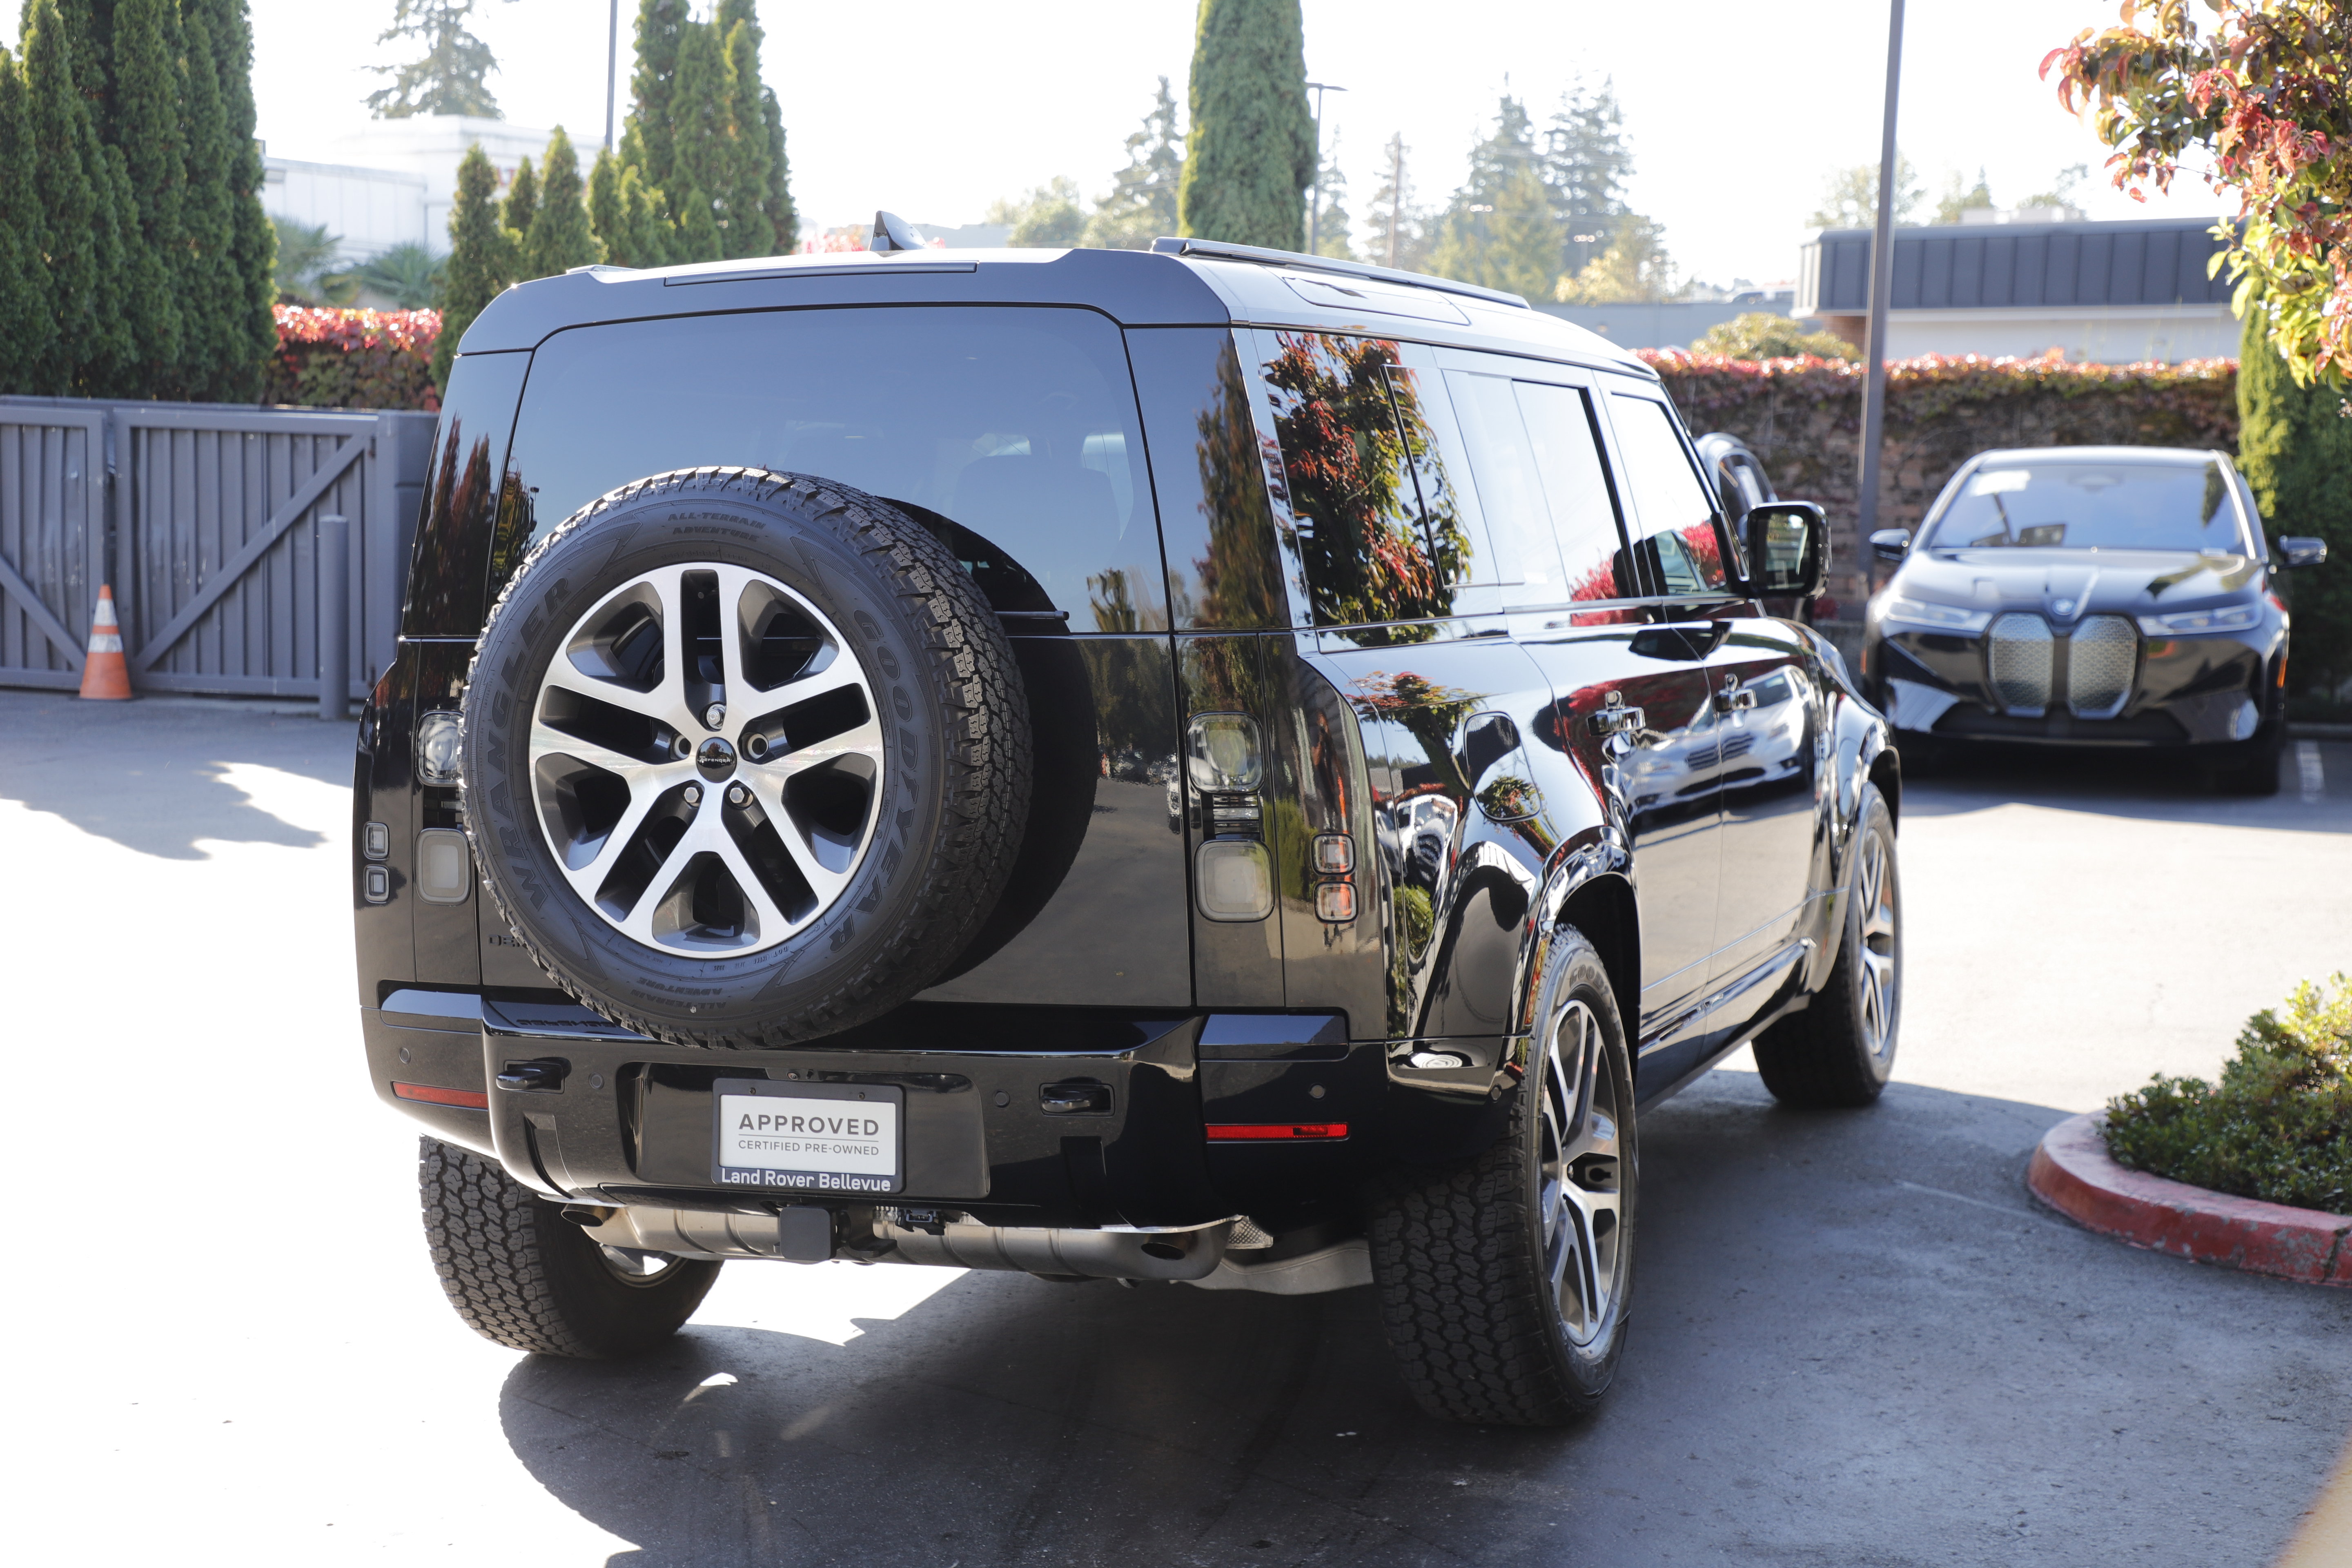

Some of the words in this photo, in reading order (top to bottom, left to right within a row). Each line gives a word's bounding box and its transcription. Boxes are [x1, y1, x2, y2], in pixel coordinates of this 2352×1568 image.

[667, 512, 766, 529] ALL-TERRAIN
[673, 526, 760, 542] ADVENTURE
[488, 577, 570, 911] WRANGLER
[827, 610, 919, 952] GOODYEAR
[636, 977, 723, 996] ADVENTURE
[738, 1114, 879, 1136] APPROVED
[738, 1140, 800, 1152] CERTIFIED
[805, 1143, 879, 1156] PRE-OWNED
[722, 1168, 760, 1185] Land
[765, 1170, 815, 1187] Rover
[819, 1173, 891, 1192] Bellevue
